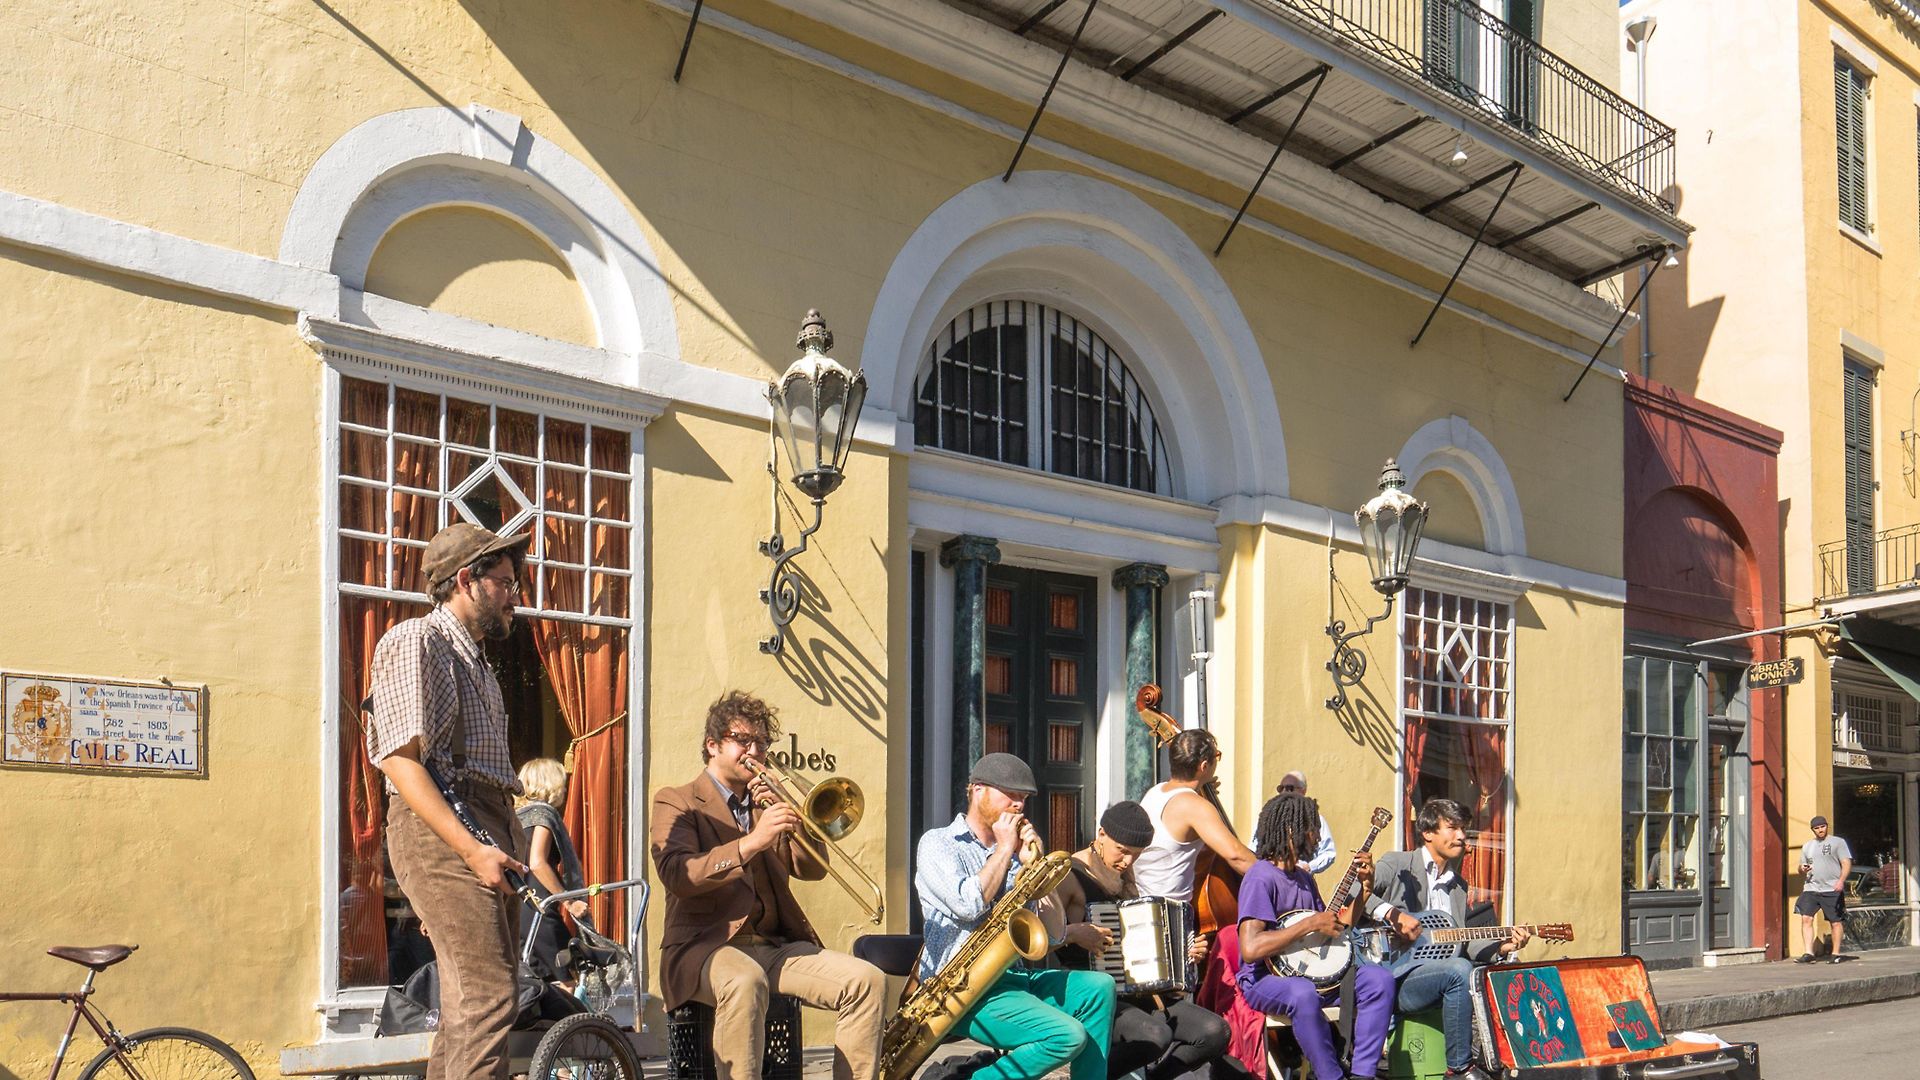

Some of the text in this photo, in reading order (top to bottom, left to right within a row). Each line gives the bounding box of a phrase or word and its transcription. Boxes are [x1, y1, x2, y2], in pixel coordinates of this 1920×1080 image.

[1758, 660, 1795, 673] BRASS
[1750, 667, 1799, 682] MONKEY
[79, 686, 99, 696] Wn
[118, 690, 143, 699] Orleans
[158, 692, 169, 701] the
[105, 698, 131, 710] Spanish
[133, 700, 163, 710] Province
[103, 718, 124, 728] 1762
[148, 720, 168, 731] 1803
[86, 726, 101, 736] This
[103, 730, 124, 738] street
[128, 730, 143, 739] bore
[148, 731, 159, 740] the
[136, 743, 192, 764] REAL
[1507, 972, 1561, 1021] EIGHT DICE
[1529, 1036, 1565, 1063] CLOTH
